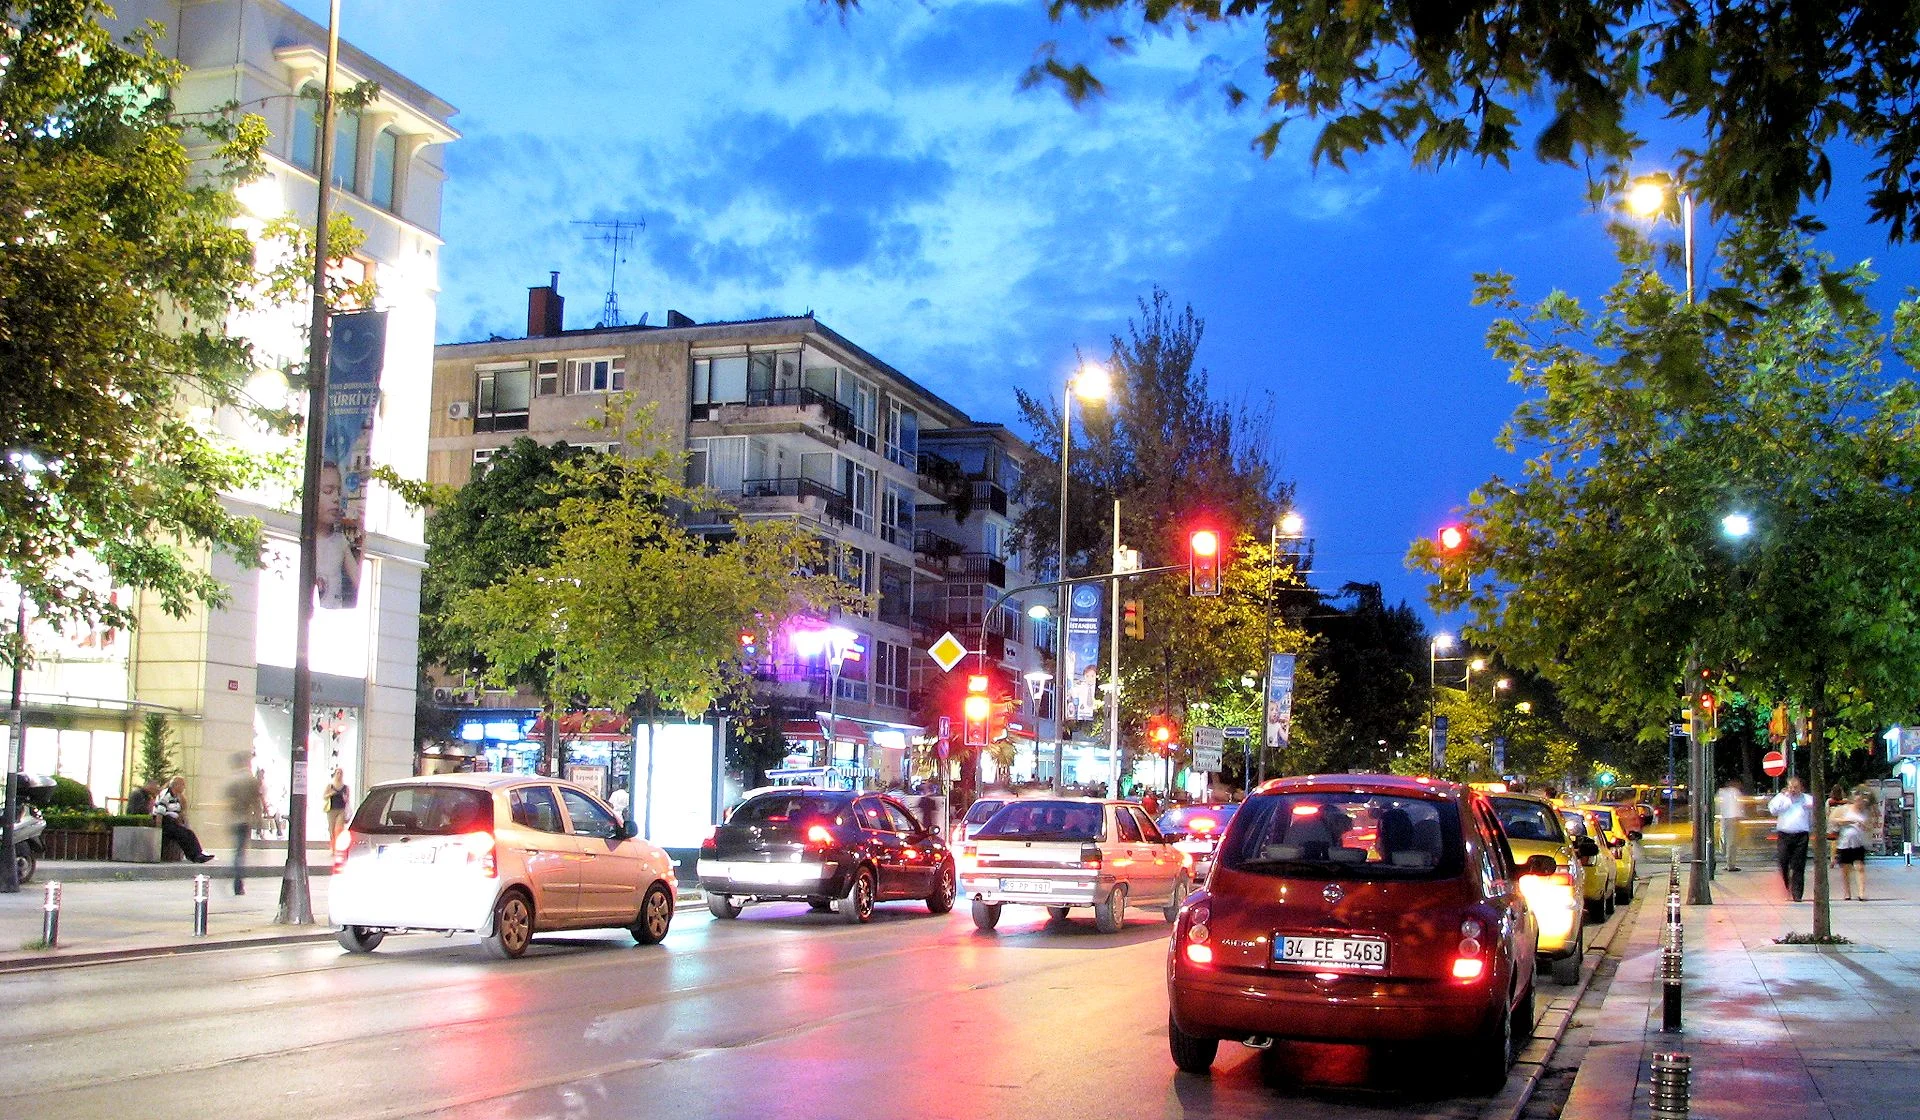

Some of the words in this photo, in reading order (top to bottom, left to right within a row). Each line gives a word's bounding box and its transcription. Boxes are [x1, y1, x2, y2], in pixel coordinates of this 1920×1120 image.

[328, 390, 377, 407] TÜRKİYE
[1069, 621, 1097, 630] İSTANBUL
[1285, 939, 1304, 958] 34
[1314, 941, 1335, 959] EE
[1343, 942, 1383, 962] 5463
